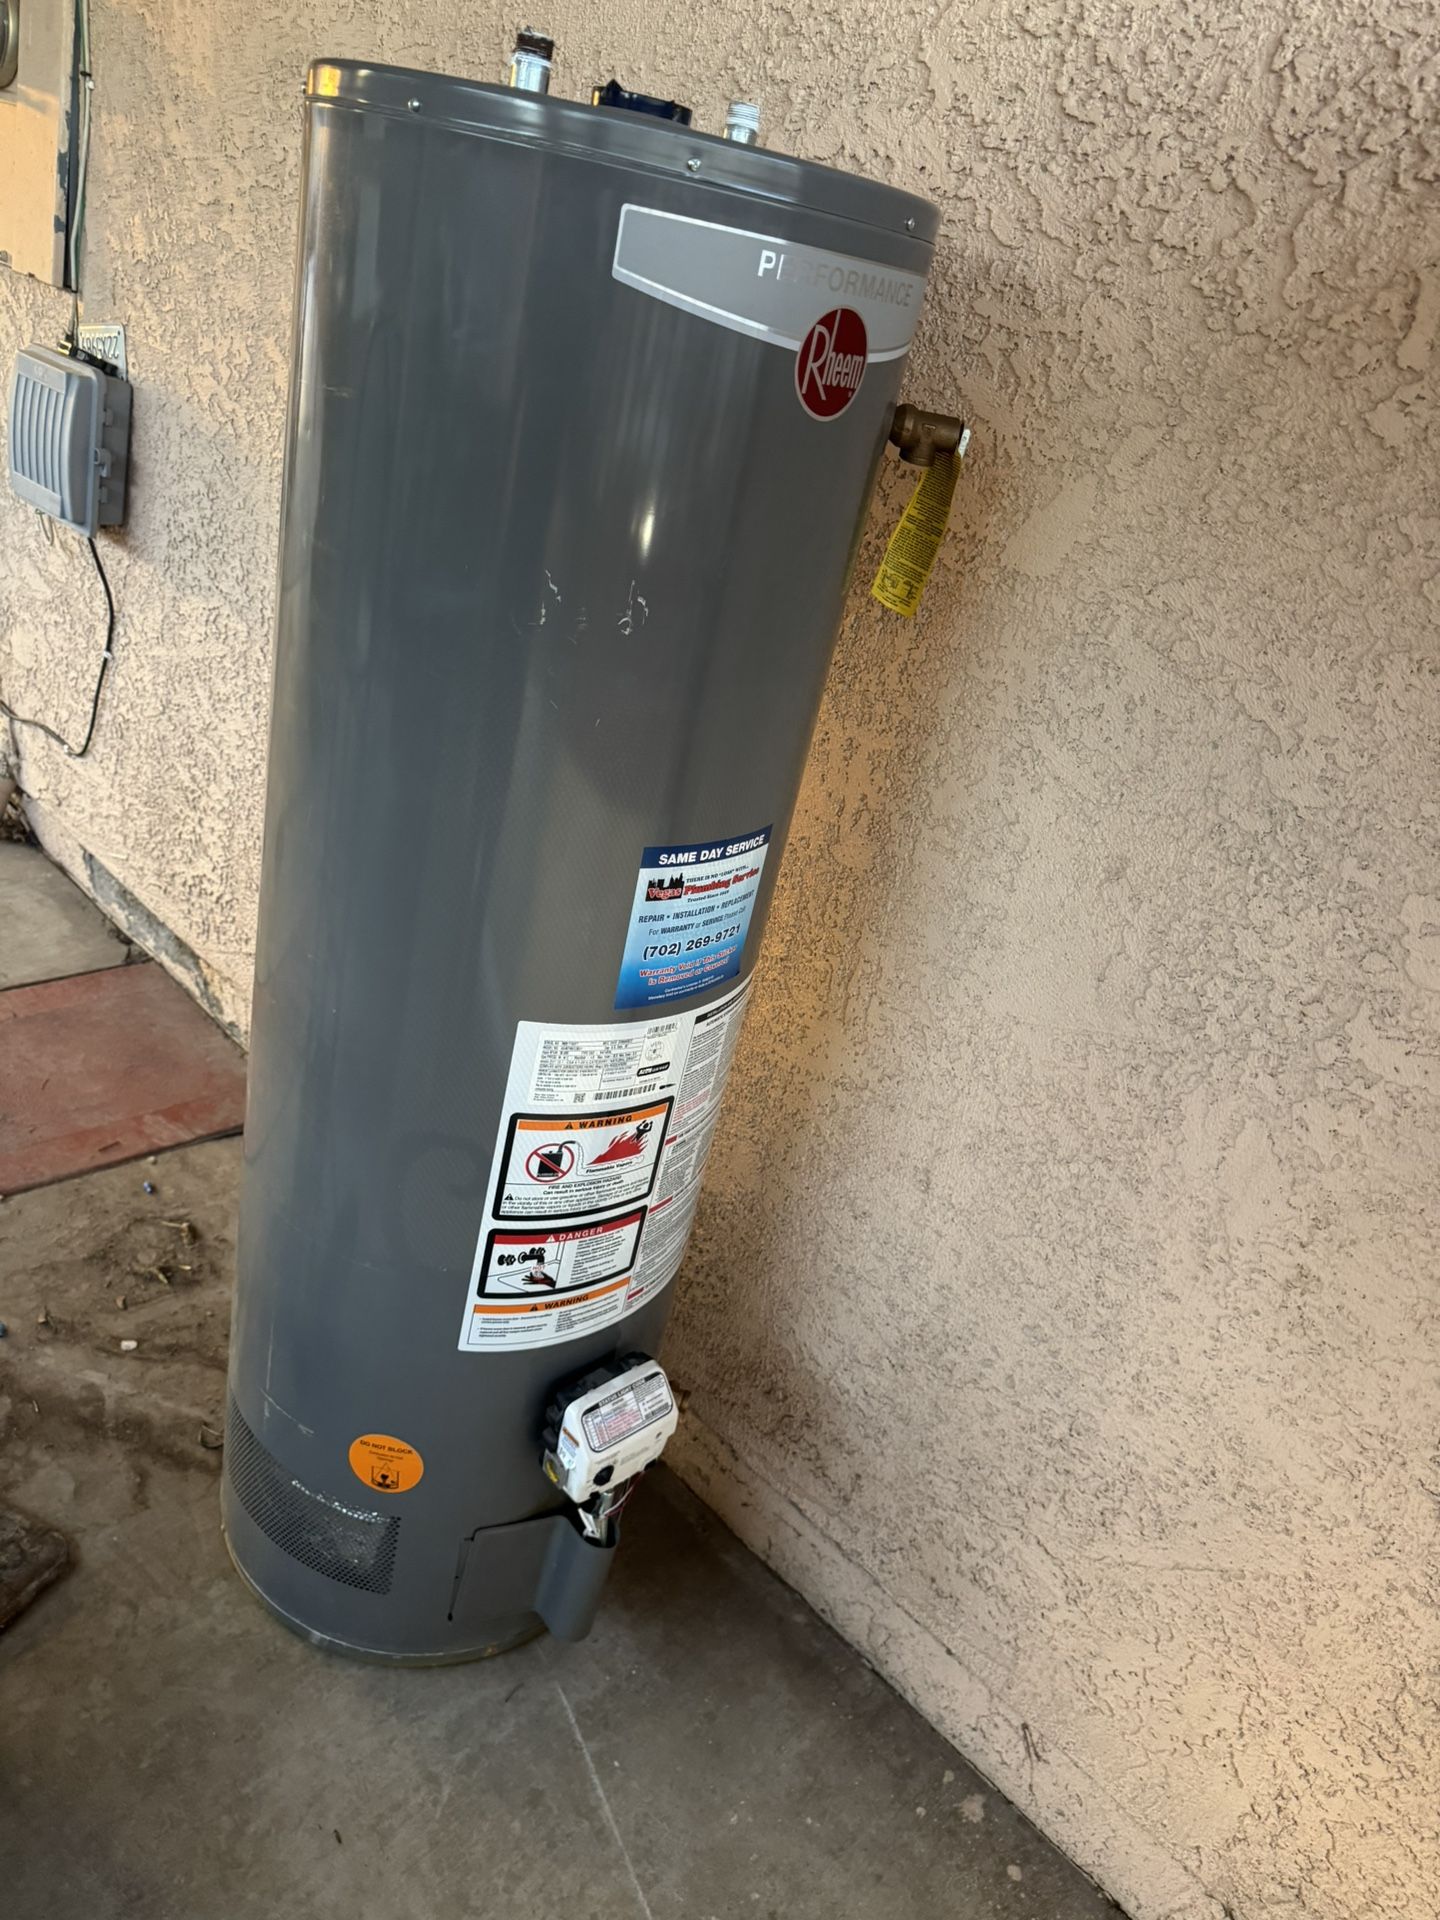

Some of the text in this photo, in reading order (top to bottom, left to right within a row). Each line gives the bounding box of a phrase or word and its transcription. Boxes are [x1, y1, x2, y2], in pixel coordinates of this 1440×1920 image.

[801, 309, 865, 400] Rheem
[658, 834, 766, 865] SAME DAY SERVICE
[647, 887, 682, 899] Vegas
[683, 878, 732, 896] Plumbing
[732, 867, 760, 885] Service
[638, 913, 665, 923] REPAIR
[672, 903, 715, 920] INSTALLATION
[721, 890, 755, 909] REPLACEMENT
[648, 928, 660, 936] For
[660, 922, 695, 935] WARRANTY
[702, 915, 724, 927] SERVICE
[643, 924, 741, 960] (702) 269-9721
[640, 966, 676, 977] Warranty
[658, 970, 695, 984] Removed
[578, 1115, 633, 1129] WARNING
[586, 1161, 633, 1174] Flammable Vapors
[574, 1179, 602, 1188] EXPLOSION
[559, 1227, 603, 1241] DANGER
[544, 1294, 589, 1310] WARNING
[371, 1442, 386, 1451] NOT
[387, 1446, 414, 1455] BLOCK
